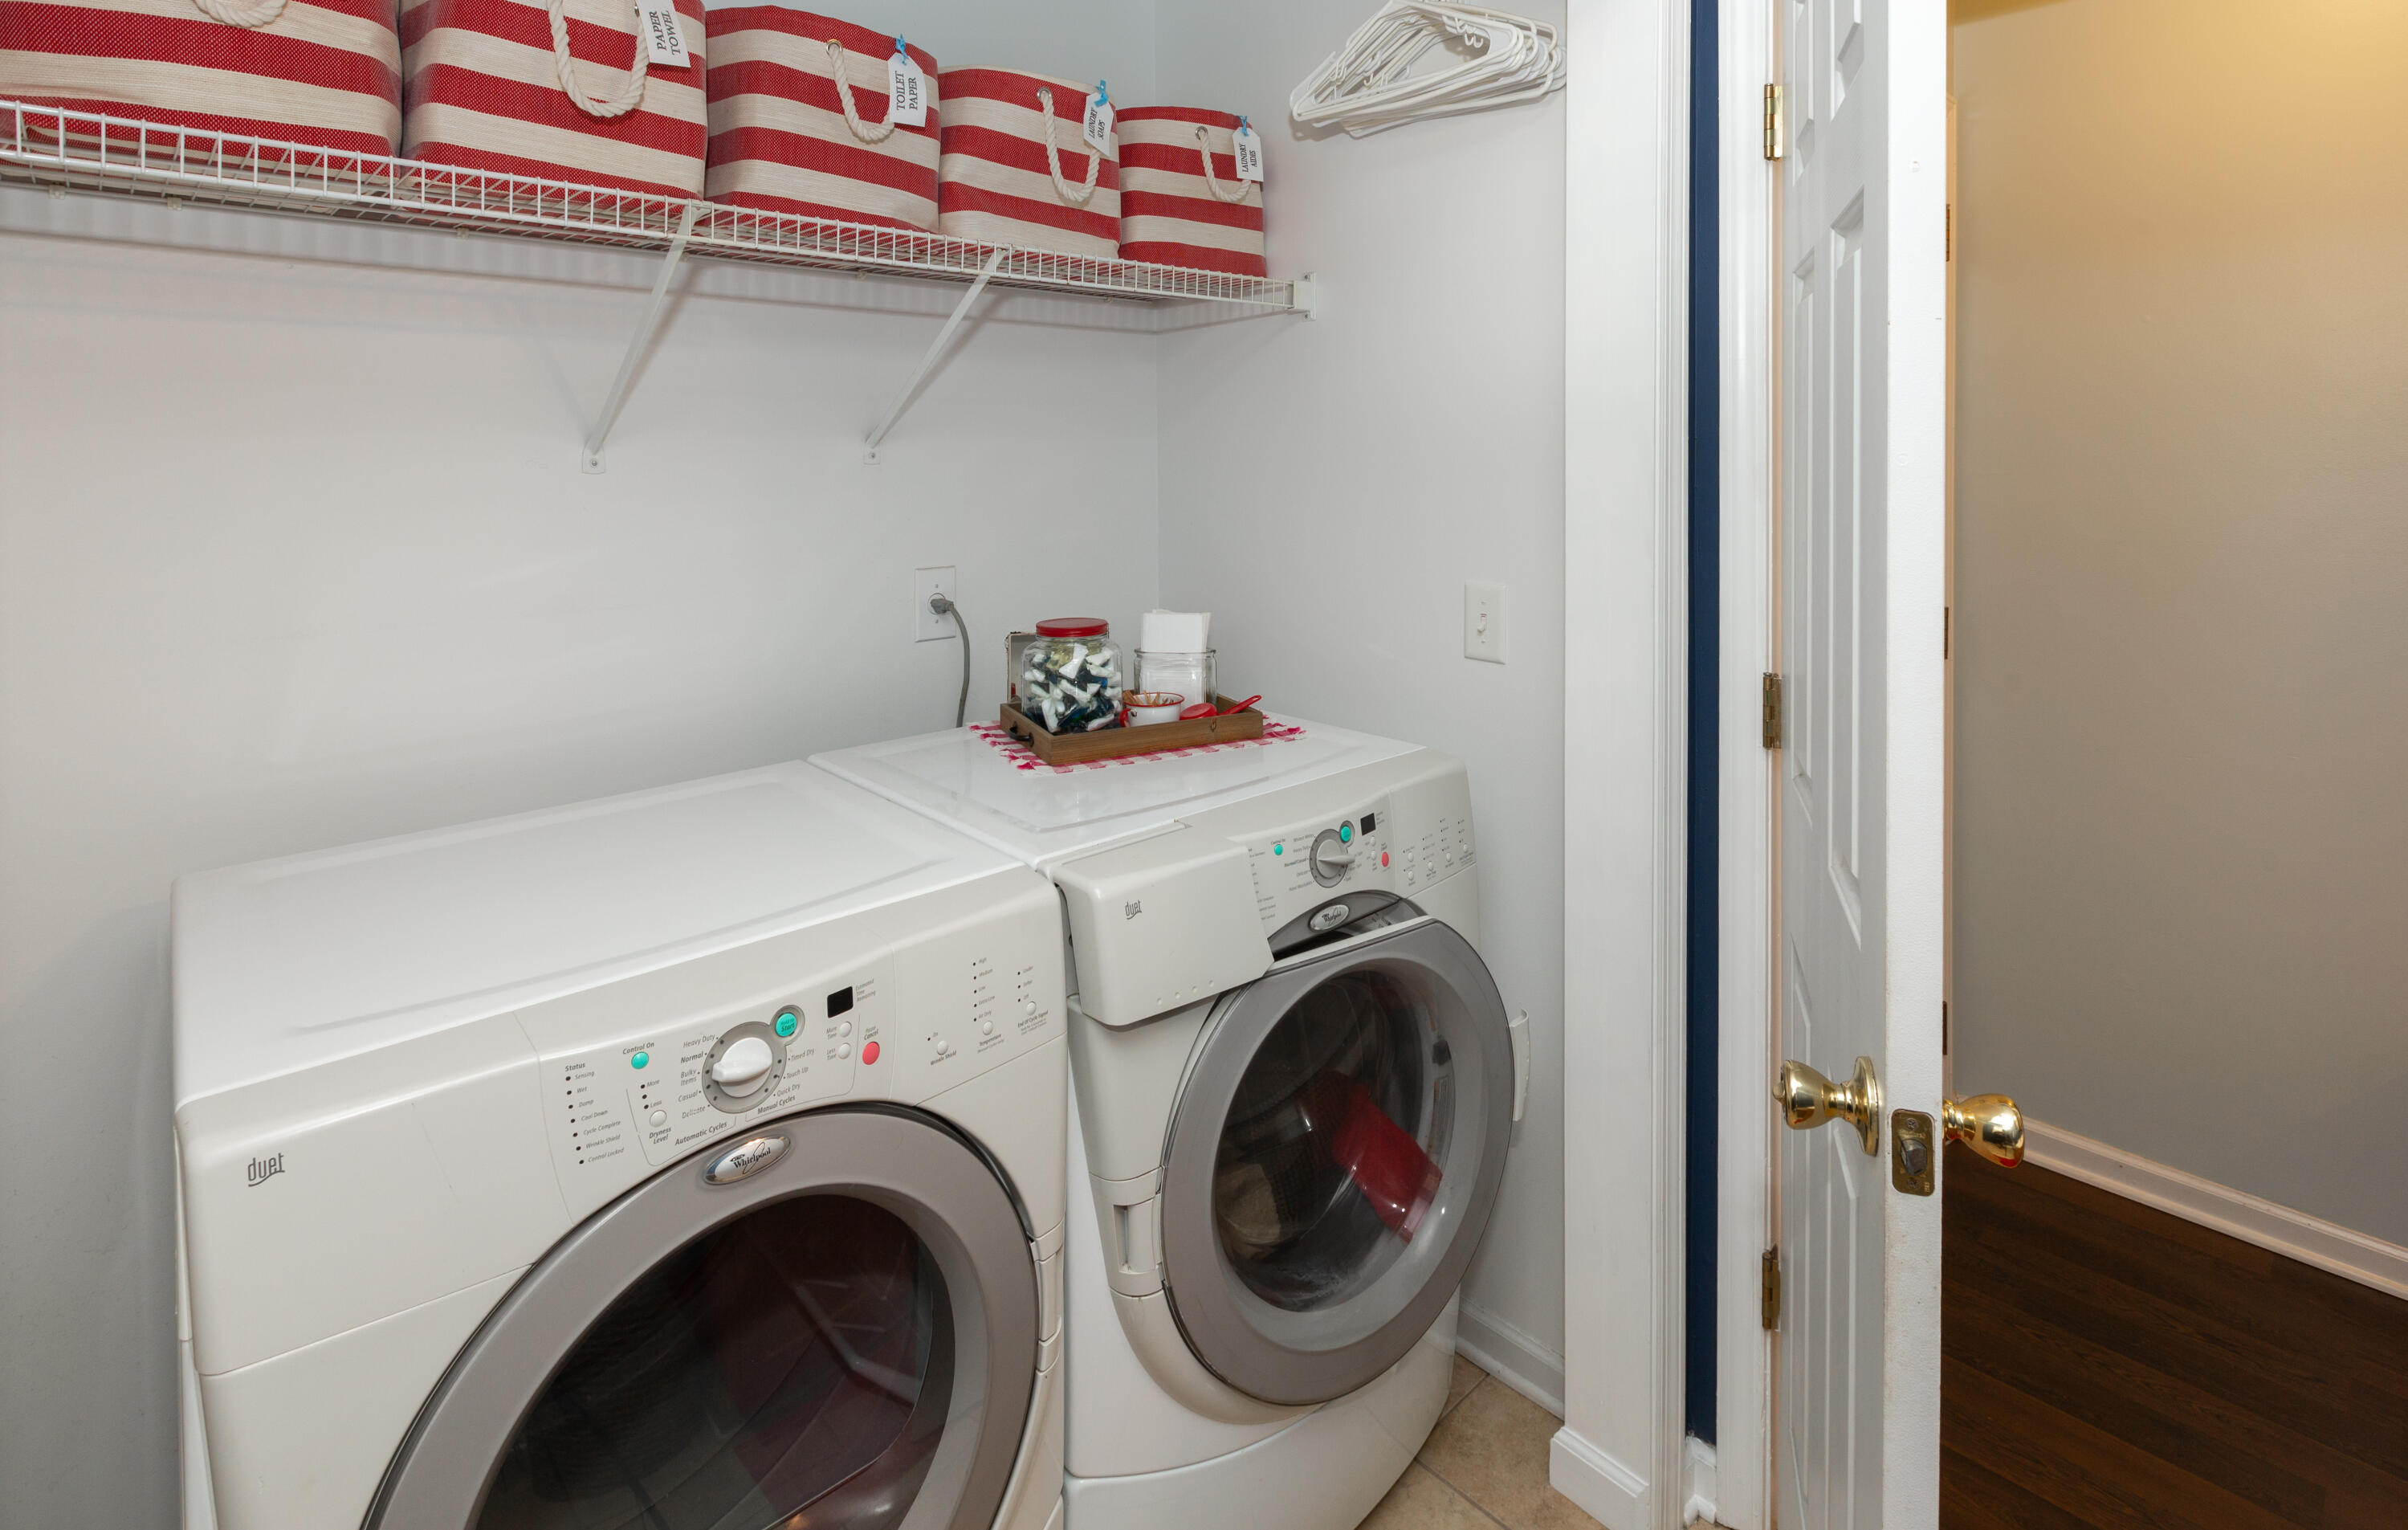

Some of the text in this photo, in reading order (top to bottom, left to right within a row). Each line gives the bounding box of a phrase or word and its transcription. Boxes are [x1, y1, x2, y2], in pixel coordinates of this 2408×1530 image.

[649, 10, 666, 51] PAPER
[662, 10, 680, 55] TOWEL
[895, 71, 906, 110] TOILET
[908, 77, 919, 110] PAPER
[1089, 107, 1098, 139] LAUNDRY
[1239, 143, 1249, 173] LAUNDRY
[1125, 900, 1142, 917] duet
[781, 1023, 795, 1033] Start
[864, 1029, 878, 1040] Cancel
[683, 1034, 715, 1048] Heavy Duty
[622, 1044, 646, 1055] Control
[791, 1048, 815, 1061] Timed Dry
[681, 1051, 703, 1063] Normal
[565, 1063, 585, 1071] Status
[681, 1069, 697, 1079] Bulky
[575, 1071, 595, 1080] Sensing
[681, 1076, 697, 1087] Items
[787, 1070, 801, 1079] Touch
[646, 1079, 660, 1087] More
[777, 1083, 800, 1097] Quick Dry
[678, 1090, 698, 1103] Casual
[579, 1100, 594, 1108] Damp
[650, 1100, 662, 1108] Less
[758, 1095, 796, 1114] Manual Cycles
[682, 1105, 706, 1119] Delicate
[583, 1120, 621, 1136] Cycle Complete
[649, 1127, 671, 1139] Dryness
[674, 1122, 727, 1146] Automatic Cycles
[586, 1134, 621, 1149] Wrinkle Shield
[653, 1135, 669, 1144] Level
[588, 1148, 625, 1163] Control Locked
[733, 1146, 771, 1169] Whirlpool
[248, 1153, 284, 1182] duet
